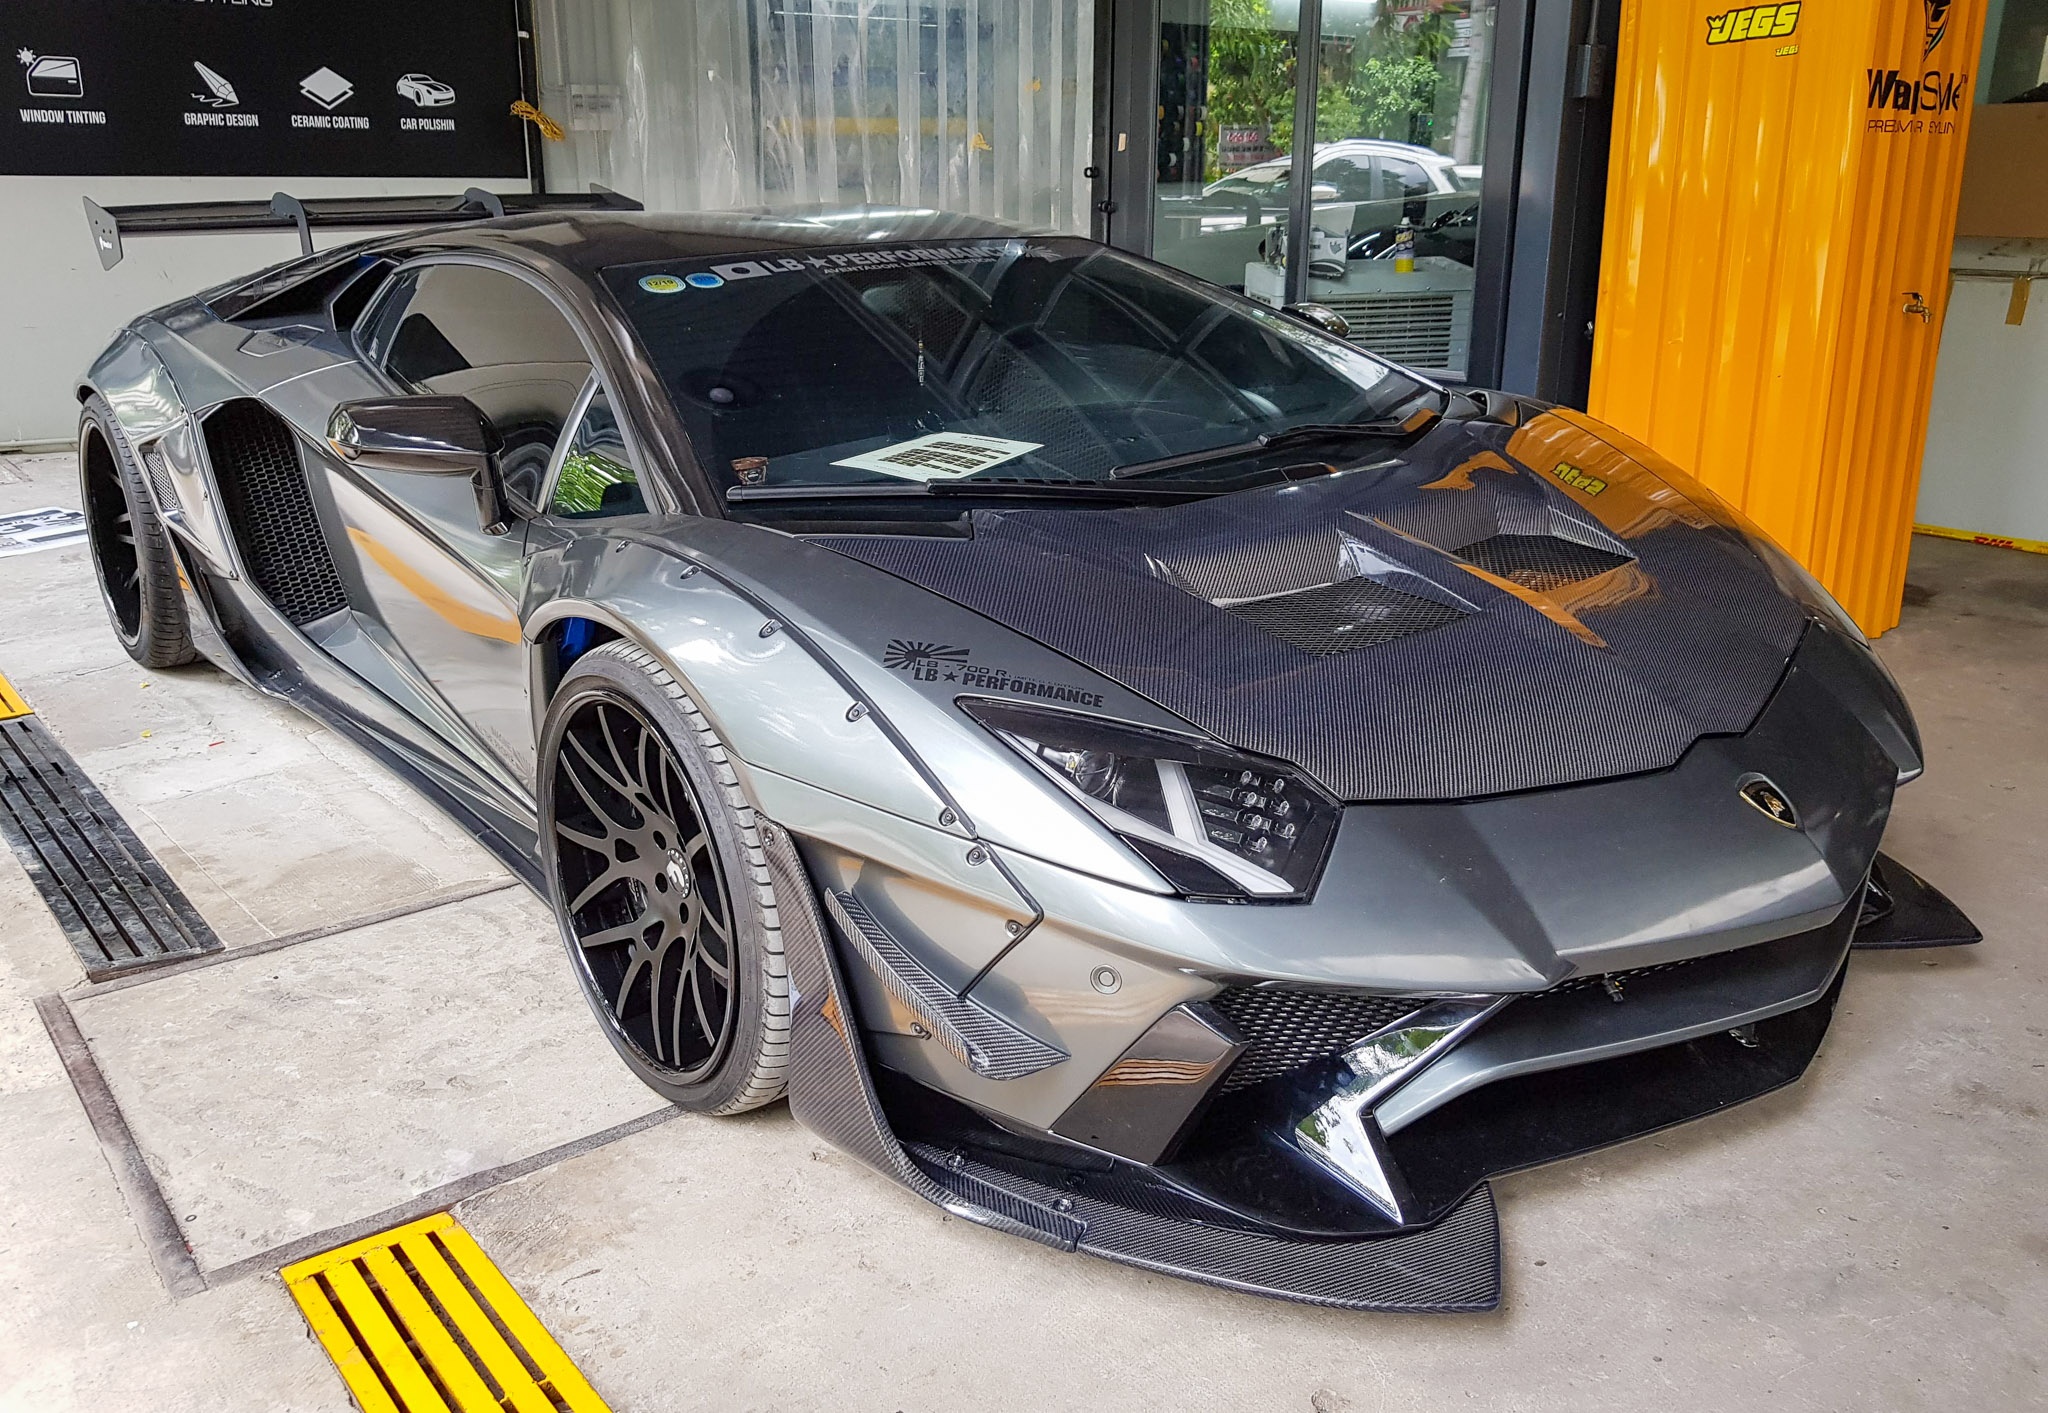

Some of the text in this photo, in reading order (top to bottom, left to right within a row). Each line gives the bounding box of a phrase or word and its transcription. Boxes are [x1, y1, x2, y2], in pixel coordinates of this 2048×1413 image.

[1707, 2, 1800, 45] JEGS
[19, 109, 106, 124] WINDOW TINTING
[184, 113, 259, 127] GRAPHIC DESIGN
[291, 115, 369, 129] CERAMIC COATING
[400, 118, 455, 131] CAR POLISHIN
[760, 245, 1013, 273] LB PERFORMANC
[956, 663, 990, 675] 700
[995, 669, 1007, 678] R
[914, 667, 1105, 708] LB PERFORMANCE
